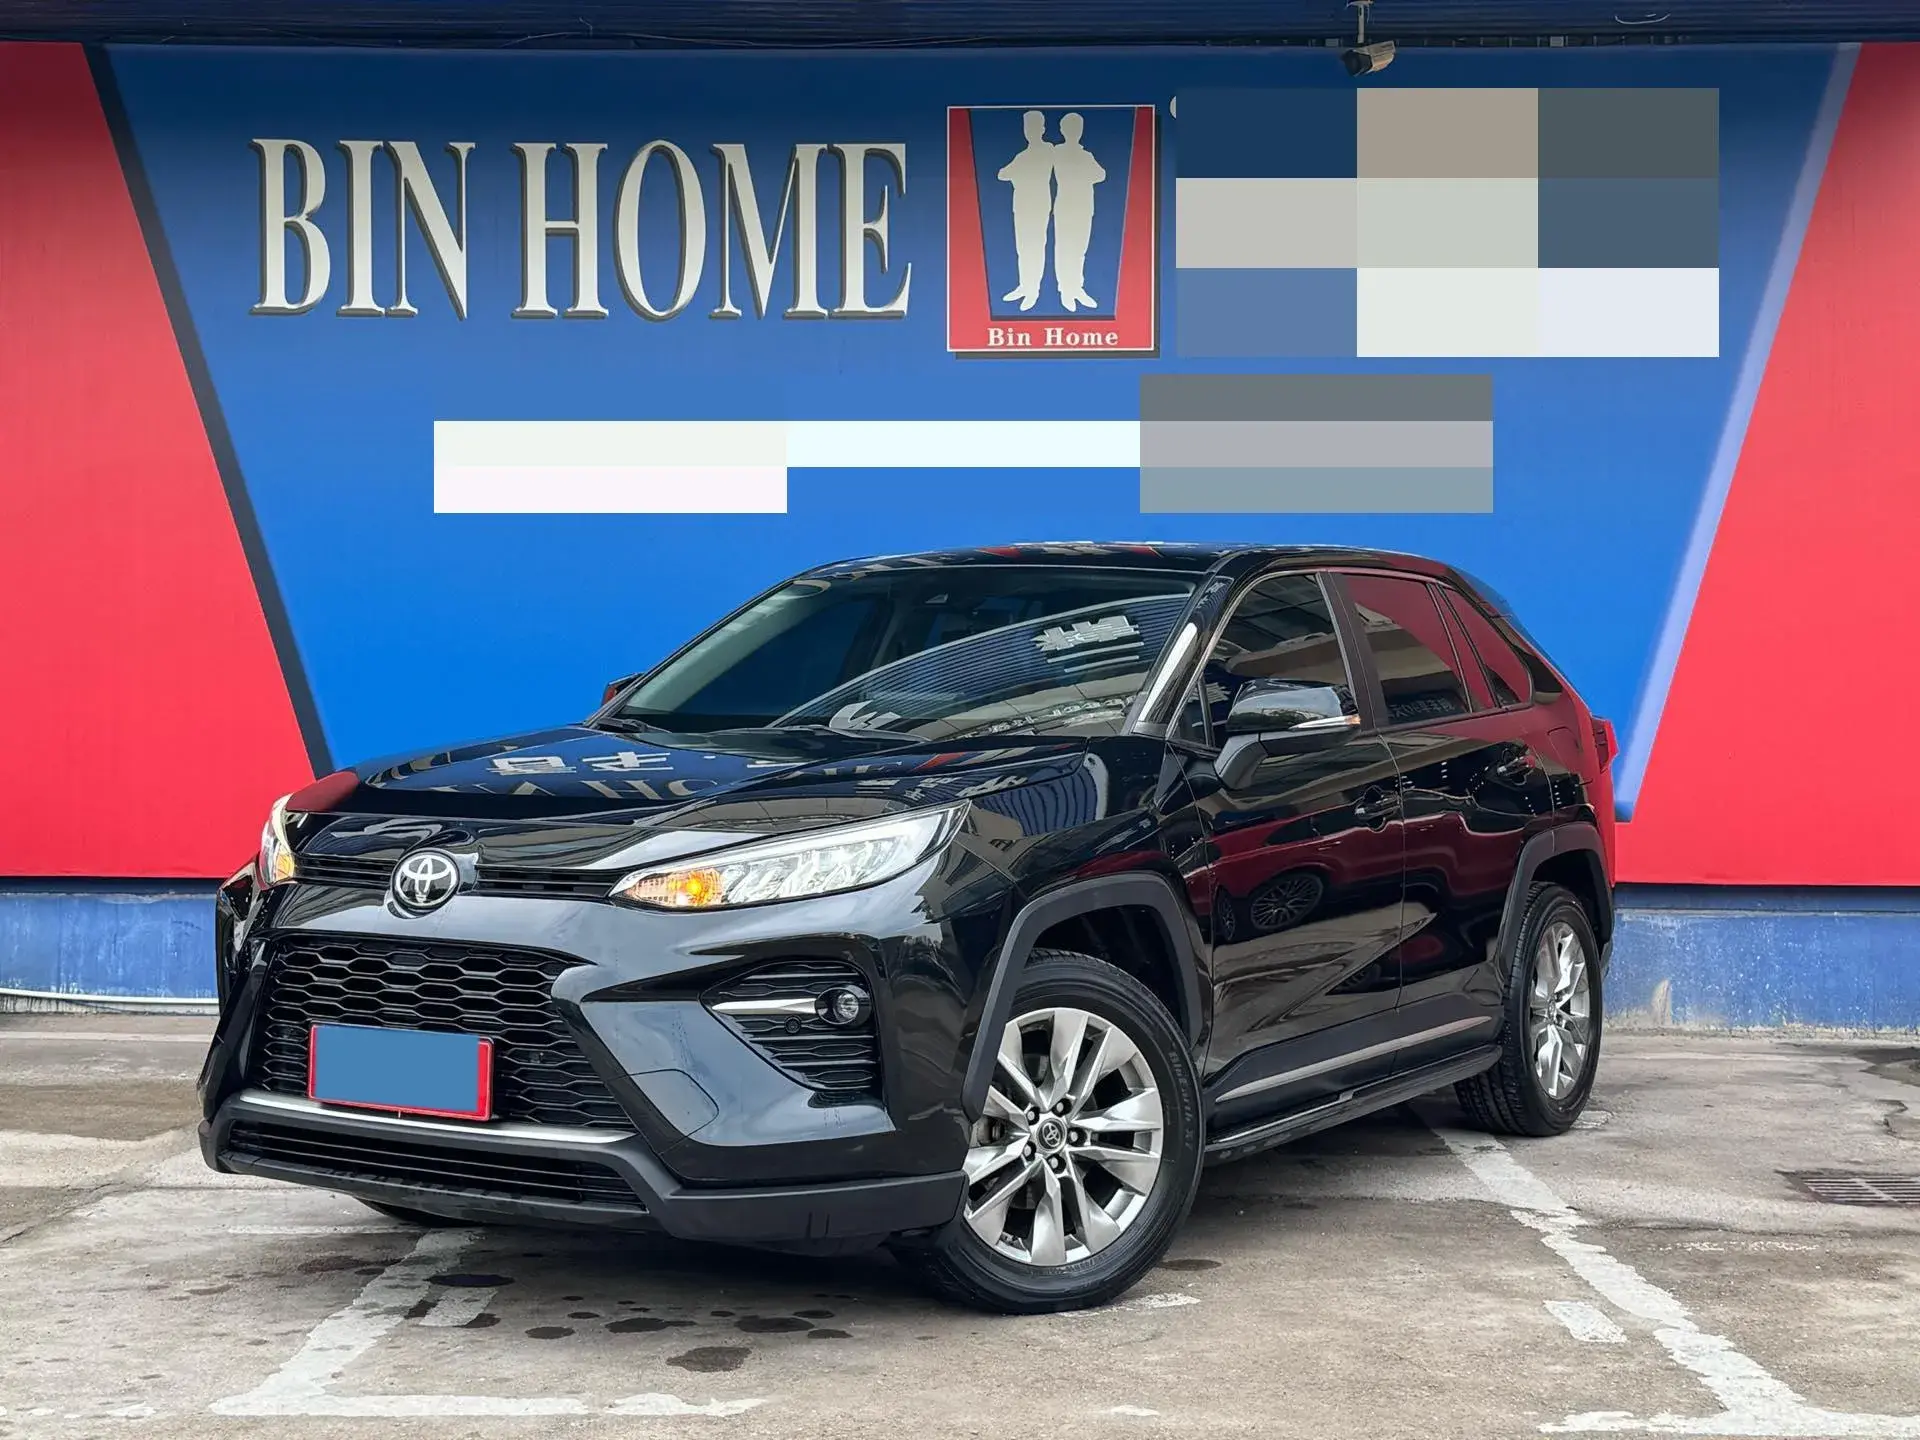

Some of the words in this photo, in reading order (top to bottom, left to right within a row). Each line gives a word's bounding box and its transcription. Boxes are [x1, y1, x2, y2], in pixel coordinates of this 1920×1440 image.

[250, 138, 476, 320] BIN
[511, 139, 912, 321] HOME
[987, 327, 1032, 346] Bin
[1044, 327, 1119, 346] Home
